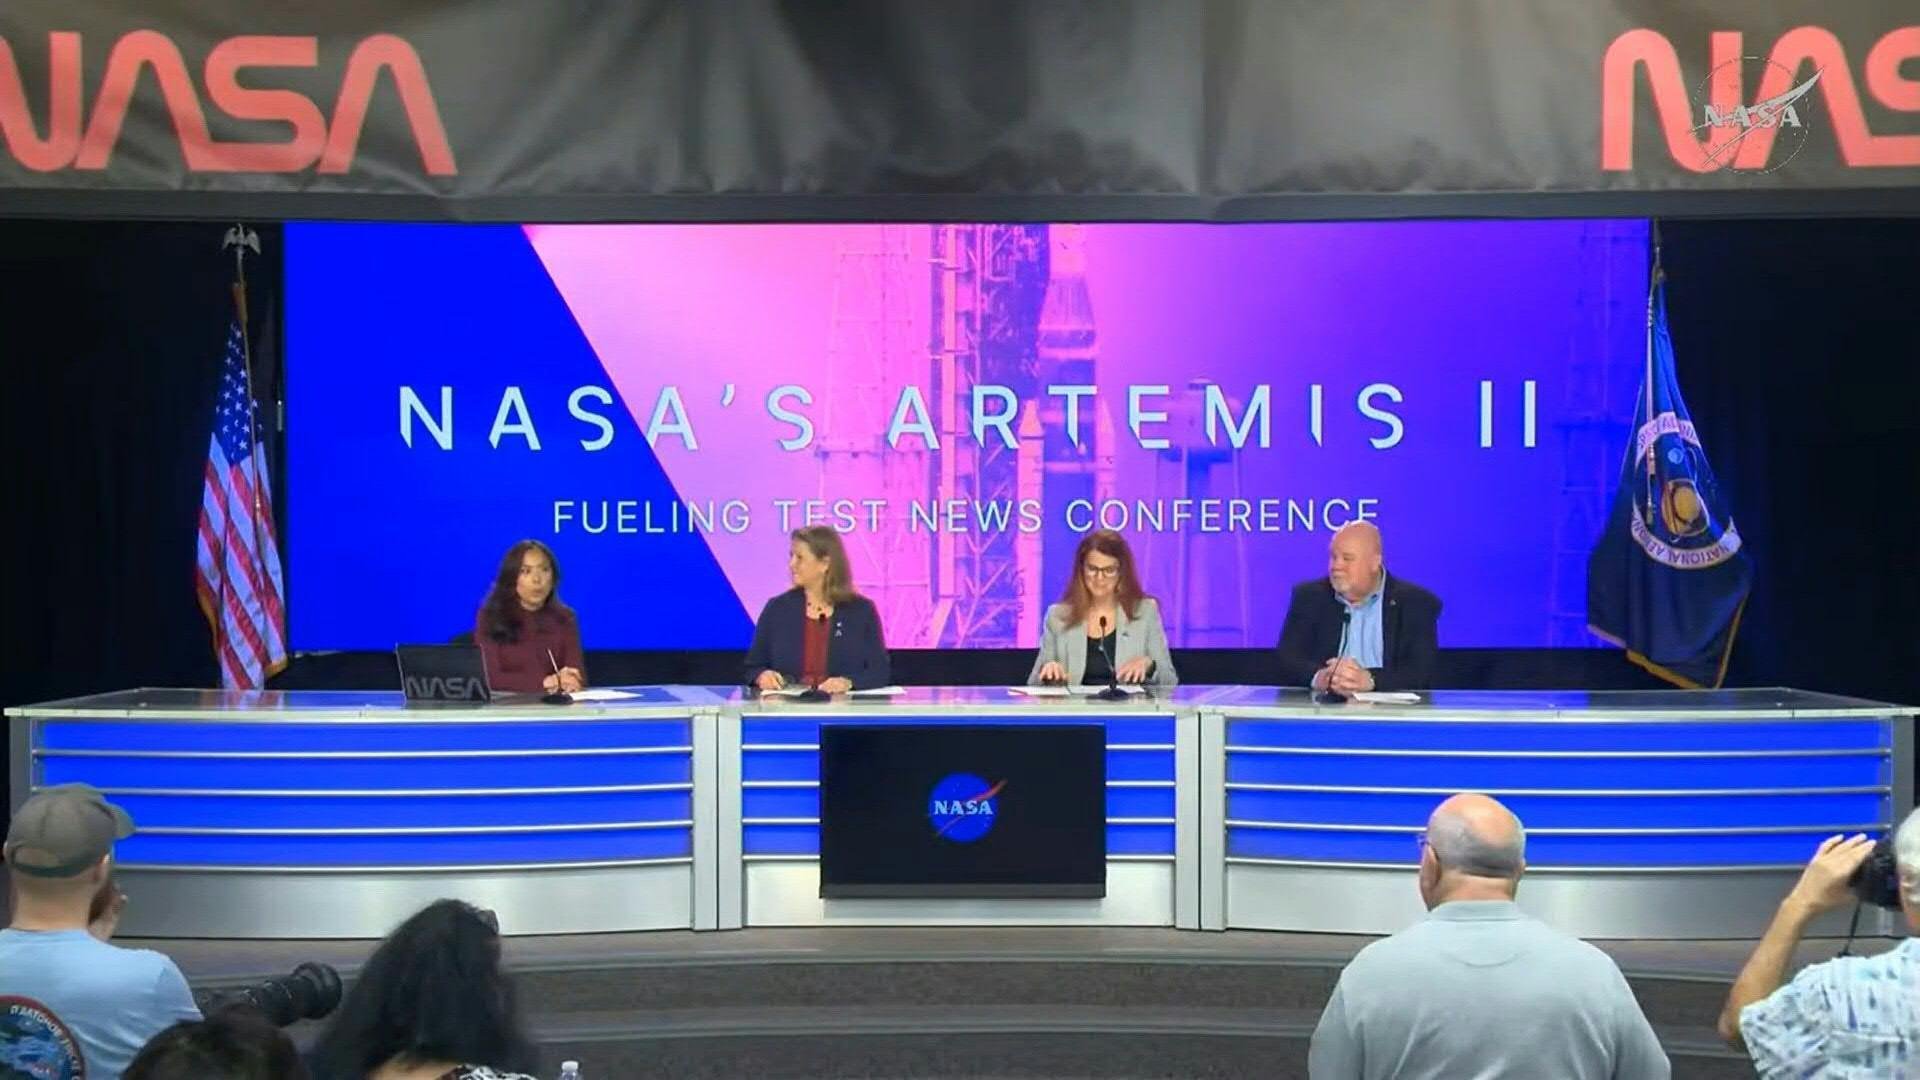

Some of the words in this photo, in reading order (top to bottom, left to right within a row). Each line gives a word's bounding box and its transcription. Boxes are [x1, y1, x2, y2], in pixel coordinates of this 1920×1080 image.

[399, 383, 814, 452] NASA'S
[887, 380, 1404, 451] ARTEMIS
[1480, 380, 1536, 449] II
[554, 500, 750, 534] FUELING
[773, 499, 888, 534] TEST
[911, 499, 1043, 533] NEWS
[1065, 498, 1379, 533] CONFERENCE
[405, 675, 488, 700] NASA
[934, 799, 994, 815] NASA
